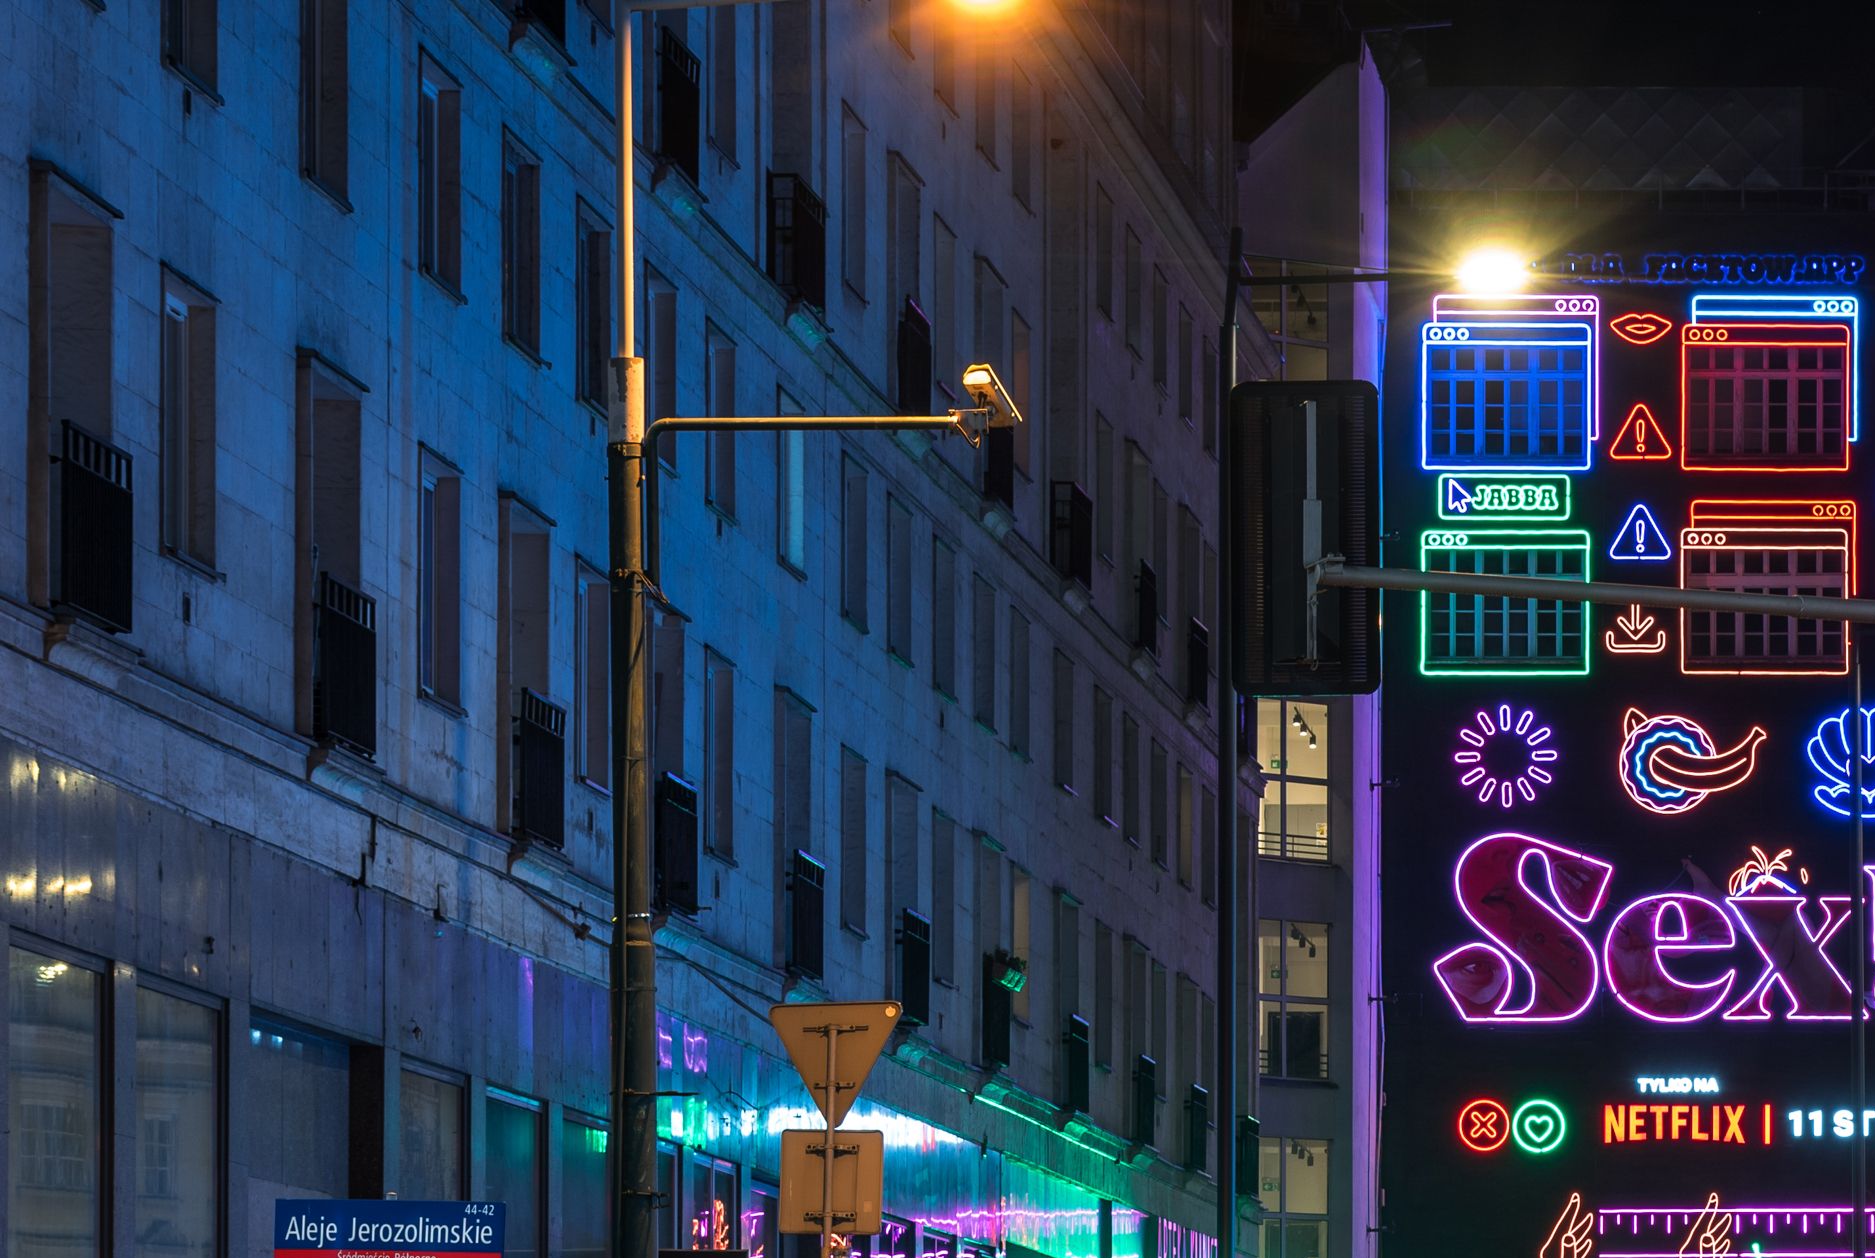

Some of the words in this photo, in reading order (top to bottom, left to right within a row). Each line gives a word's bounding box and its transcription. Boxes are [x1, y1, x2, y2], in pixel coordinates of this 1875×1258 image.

[1471, 485, 1560, 511] JABBA
[1637, 1077, 1692, 1093] TYLKO
[1693, 1077, 1720, 1093] NA
[1603, 1103, 1746, 1145] NETFLIX
[1787, 1109, 1824, 1138] 11
[464, 1204, 496, 1216] 44-42
[284, 1214, 338, 1249] Aleje
[347, 1216, 494, 1245] Jerozolimskie
